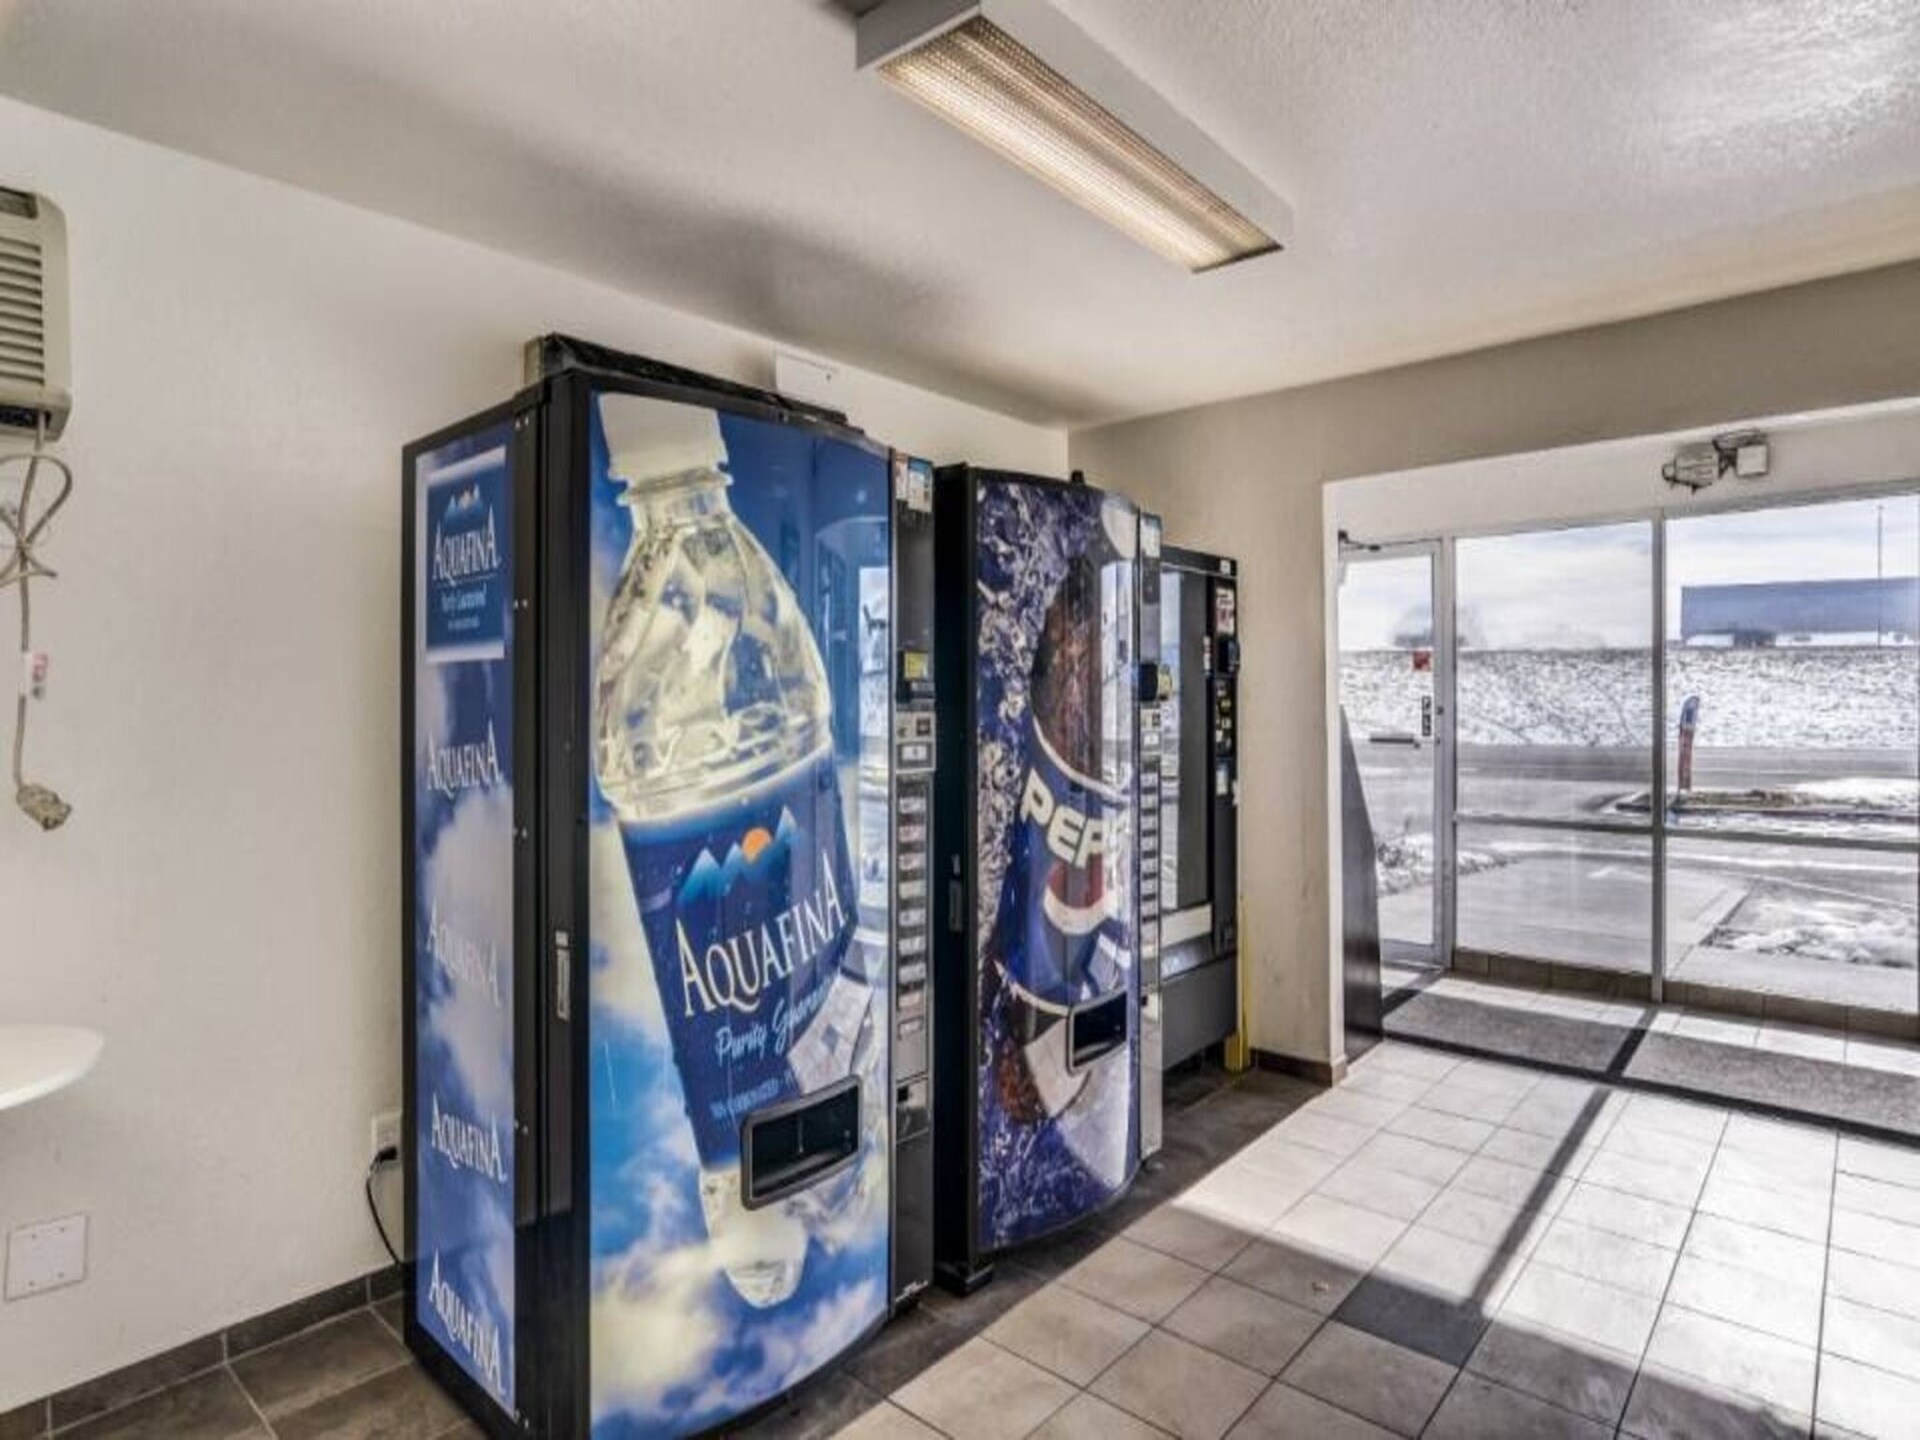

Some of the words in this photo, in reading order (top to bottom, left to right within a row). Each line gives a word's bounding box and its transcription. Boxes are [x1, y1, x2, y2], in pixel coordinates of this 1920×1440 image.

[433, 504, 500, 586] AQUAFINA
[427, 720, 502, 799] AQUAFINA
[676, 853, 848, 1013] AQUAFINA
[431, 1093, 507, 1183] AQUAFINA
[429, 1247, 506, 1395] AQUAFINA
